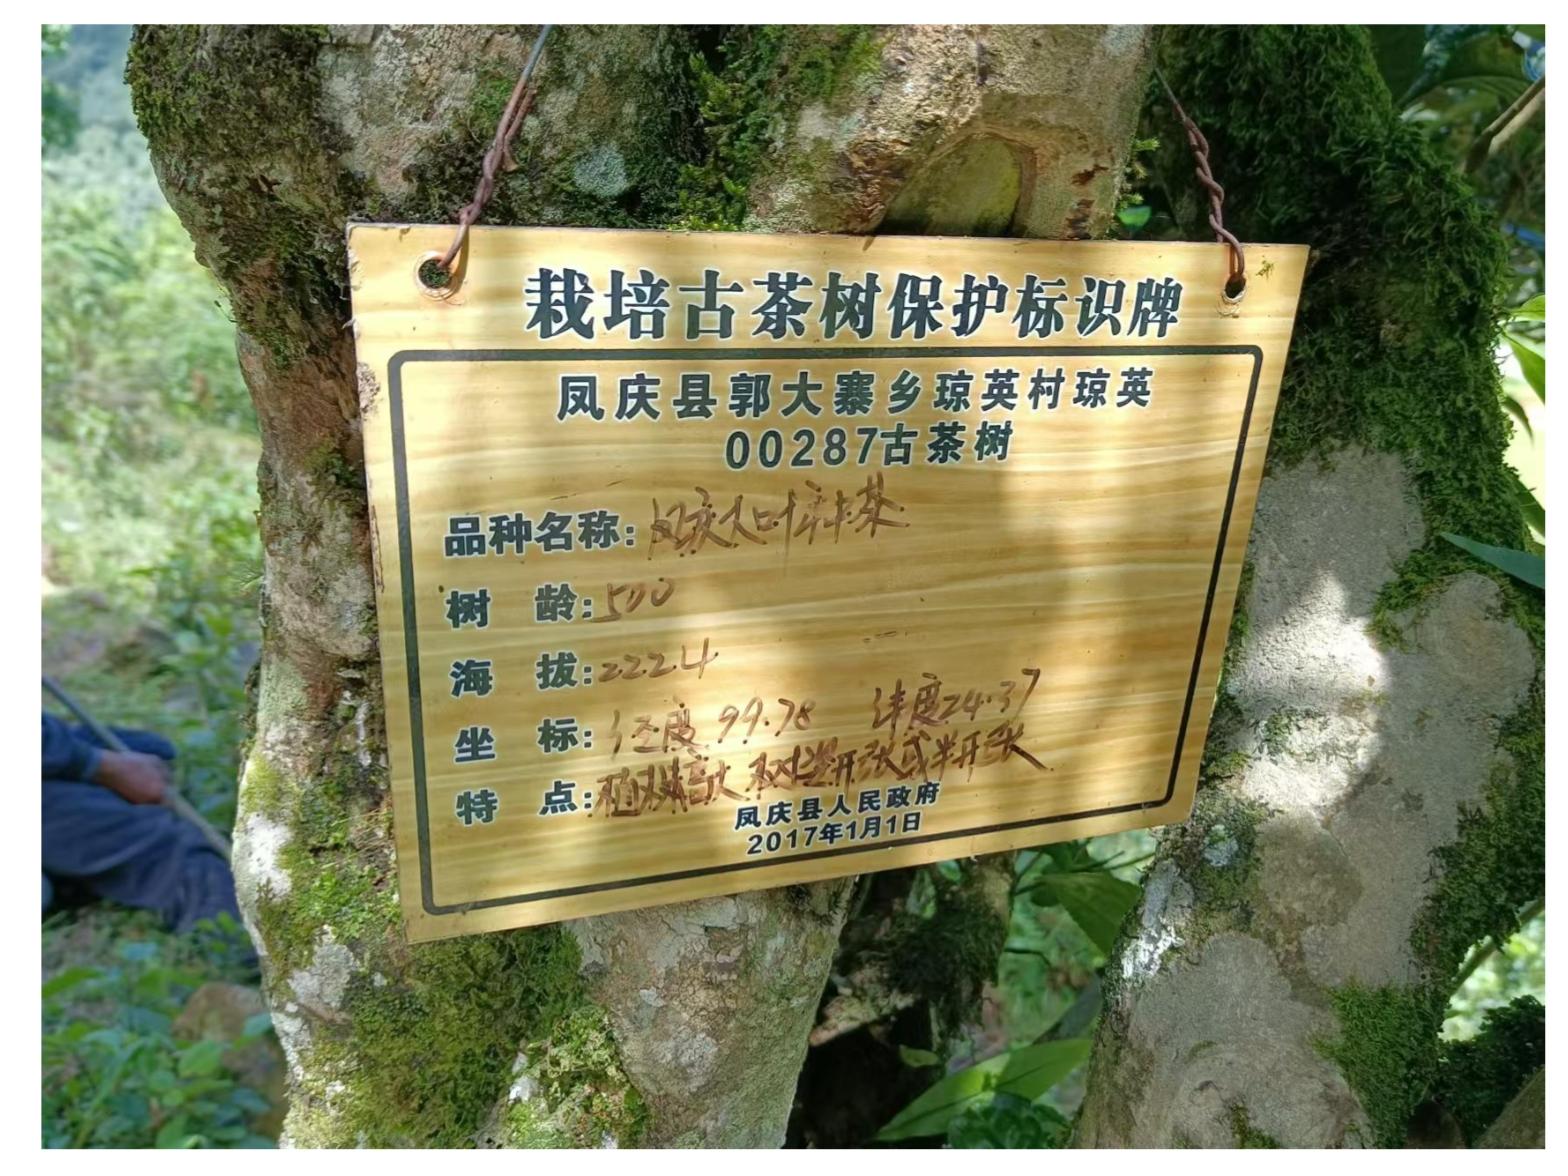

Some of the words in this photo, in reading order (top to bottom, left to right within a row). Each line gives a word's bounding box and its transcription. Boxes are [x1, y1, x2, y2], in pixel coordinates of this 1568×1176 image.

[524, 266, 1184, 342] 栽培古茶树保护标识牌
[557, 366, 1154, 422] 凤庆县郭大寨乡琼英村琼英
[724, 420, 1014, 471] 00287古茶树
[444, 510, 636, 557] 品种名称:
[734, 781, 942, 831] 凤庆县人民政府
[746, 811, 922, 856] 2017年1月1日
